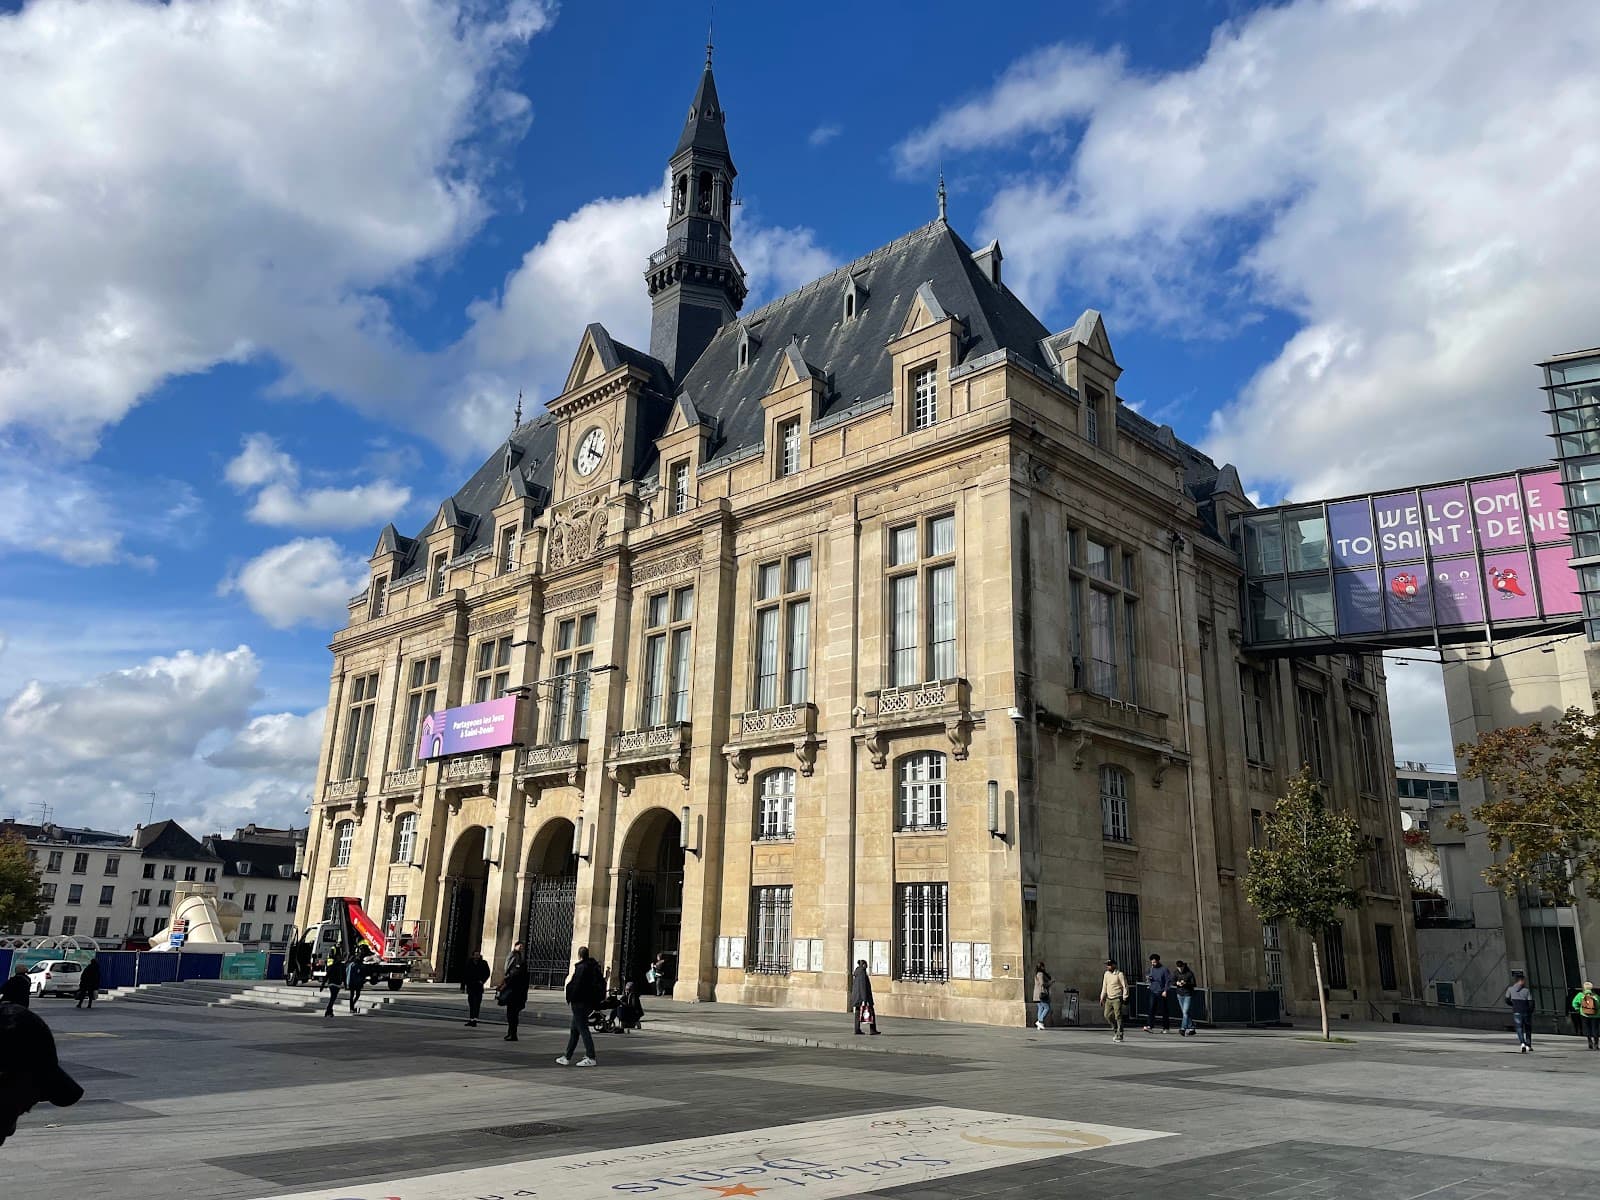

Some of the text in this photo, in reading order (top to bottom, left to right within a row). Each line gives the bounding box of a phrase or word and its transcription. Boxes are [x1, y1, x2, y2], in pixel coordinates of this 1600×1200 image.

[1378, 489, 1541, 529] WELCOME
[1337, 536, 1373, 557] TO
[611, 1157, 828, 1193] Denis
[773, 1152, 950, 1187] Saint
